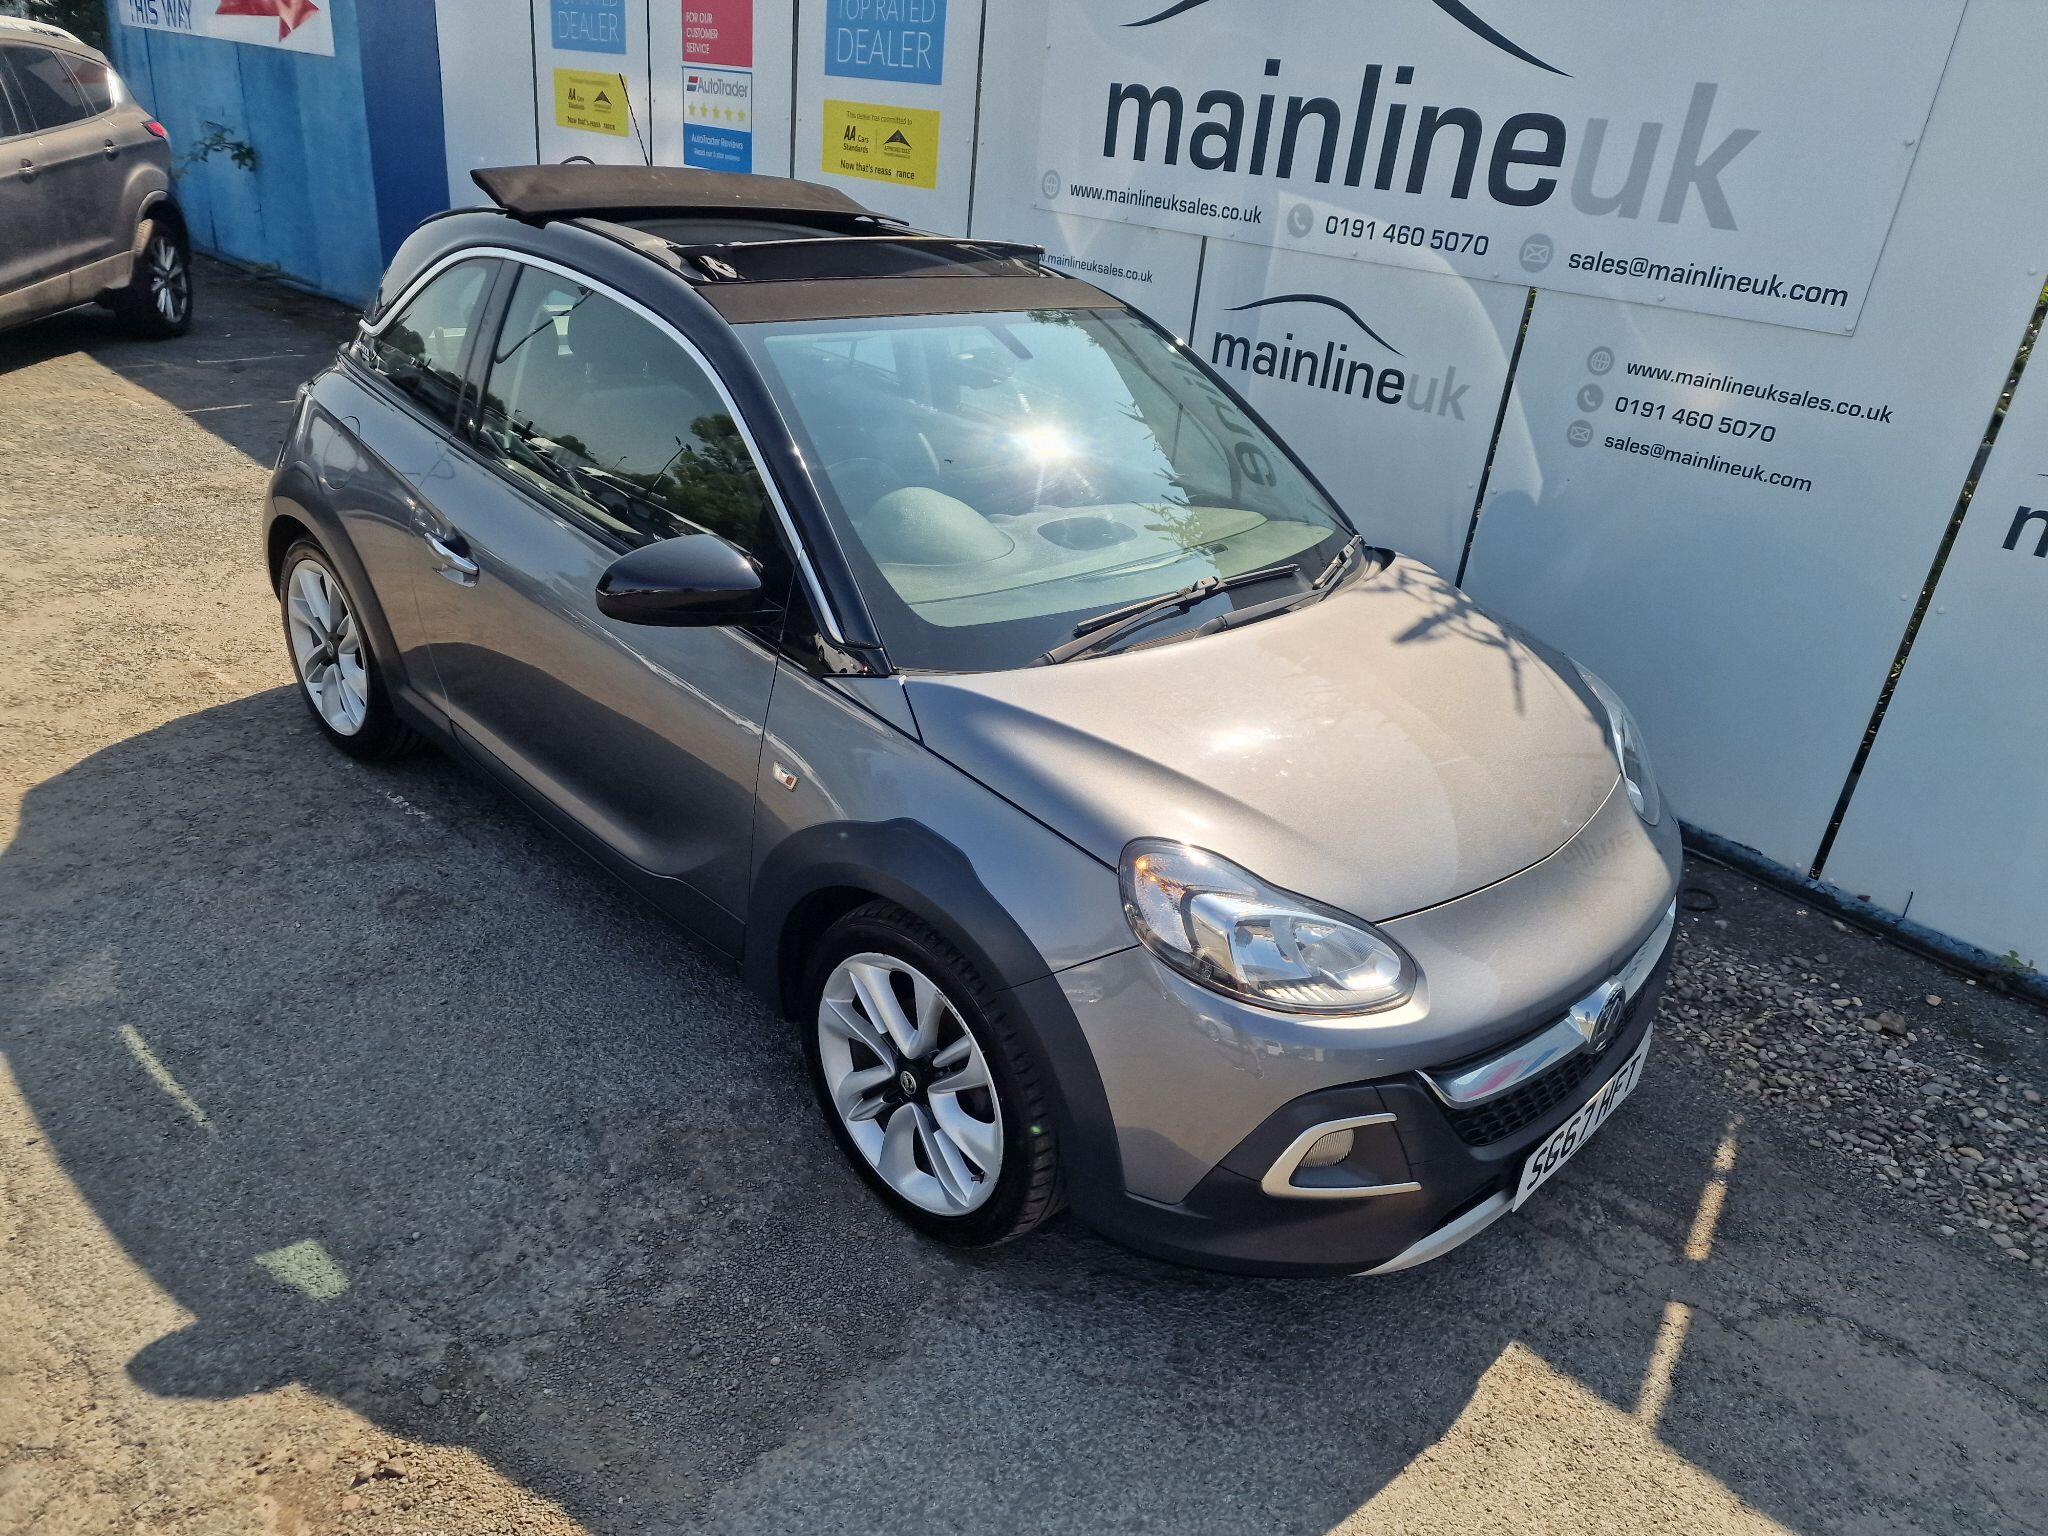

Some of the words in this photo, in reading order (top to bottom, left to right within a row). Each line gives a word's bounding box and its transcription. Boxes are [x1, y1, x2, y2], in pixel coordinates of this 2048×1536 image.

[161, 0, 192, 29] WAY
[558, 11, 619, 41] DEALER
[686, 12, 698, 22] FOR
[700, 12, 712, 24] OUR
[686, 28, 718, 40] CUSTOMER
[686, 43, 710, 54] SERVICE
[837, 27, 931, 69] DEALER
[698, 77, 748, 98] AutoTrader
[843, 143, 869, 154] Standards
[844, 125, 856, 141] AA
[858, 134, 869, 144] Cars
[1103, 58, 1762, 232] mainlineuk
[840, 160, 855, 170] Now
[855, 162, 873, 174] that's
[1070, 183, 1262, 224] www.mainlineuksales.co.uk
[1325, 215, 1376, 240] 0191
[1382, 223, 1425, 247] 460
[1430, 229, 1489, 256] 5070
[1568, 251, 1849, 307] sales@mainlineuk.com
[1211, 331, 1471, 422] mainlineuk
[1627, 362, 1893, 424] www.mainlineuksales.co.uk
[1615, 396, 1666, 421] 0191
[1672, 408, 1713, 430] 460
[1718, 416, 1776, 443] 5070
[1604, 435, 1812, 492] sales@mainlineuk.com
[1527, 1099, 1598, 1190] SG67
